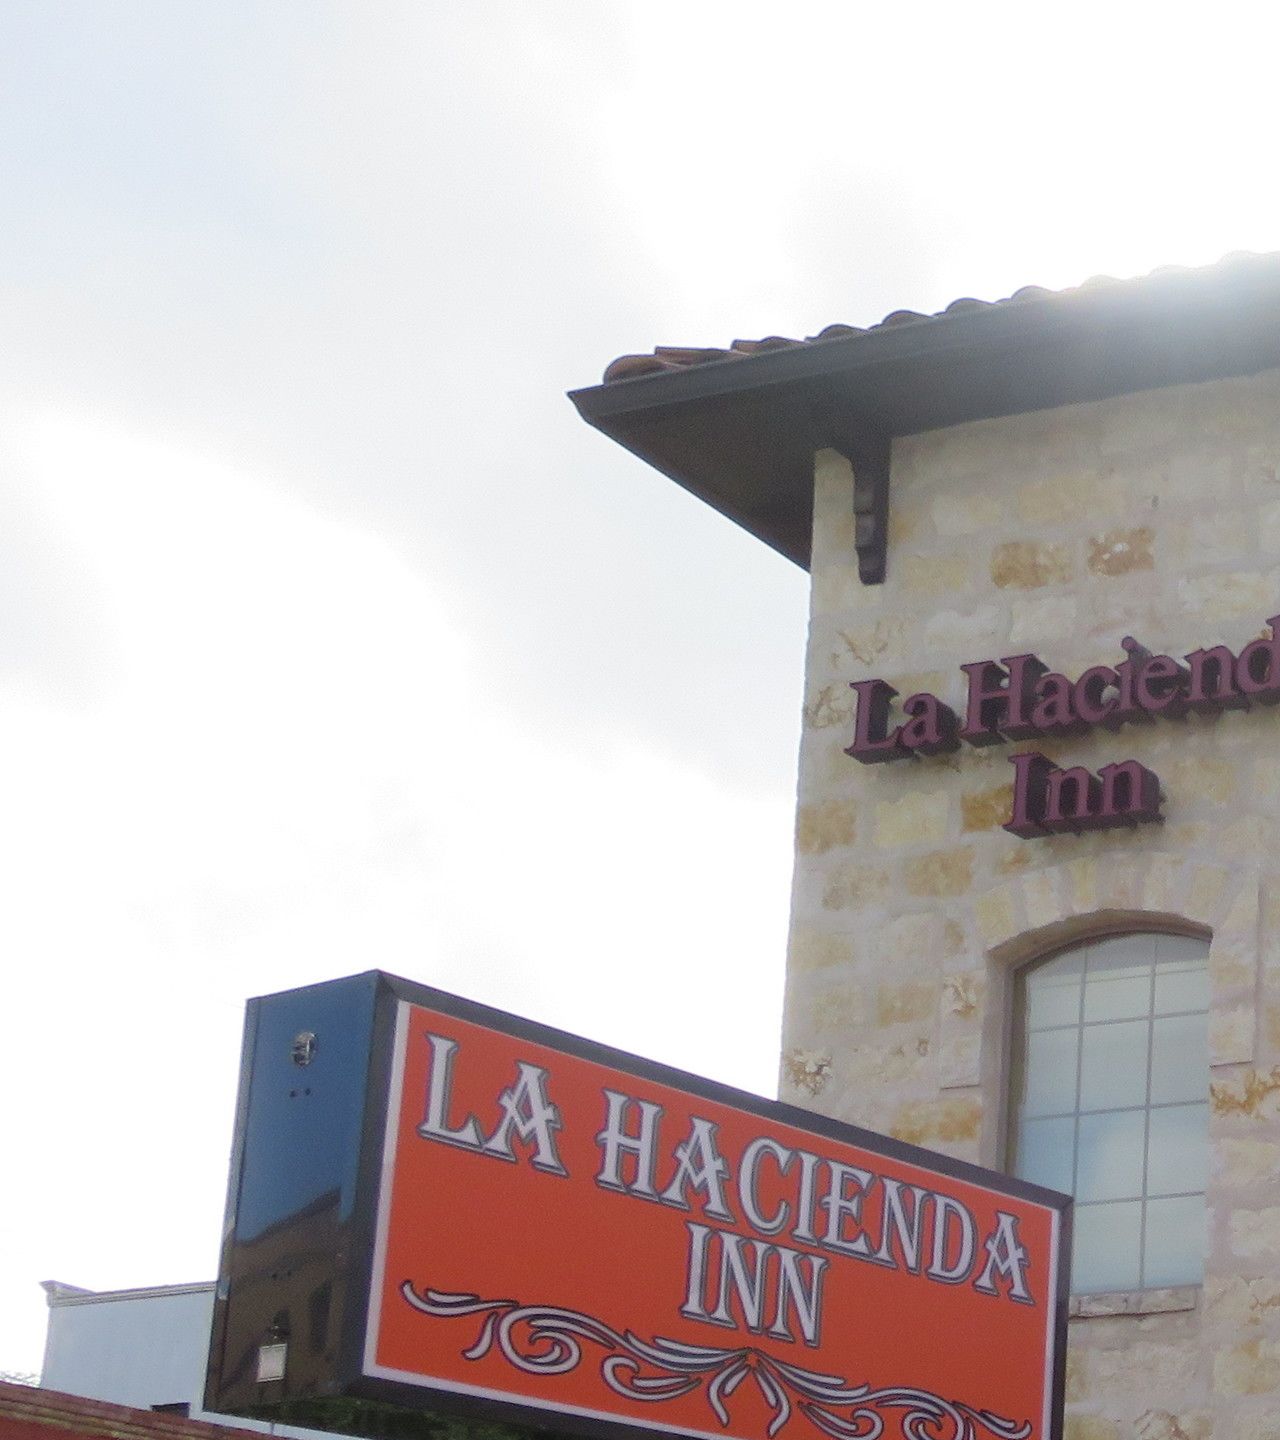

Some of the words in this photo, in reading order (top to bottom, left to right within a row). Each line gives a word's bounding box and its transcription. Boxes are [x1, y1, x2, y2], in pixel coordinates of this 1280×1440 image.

[844, 678, 960, 764] La
[1002, 751, 1166, 839] Inn
[418, 1032, 568, 1177] LA
[595, 1089, 1035, 1304] HACIENDA
[681, 1221, 829, 1348] INN
